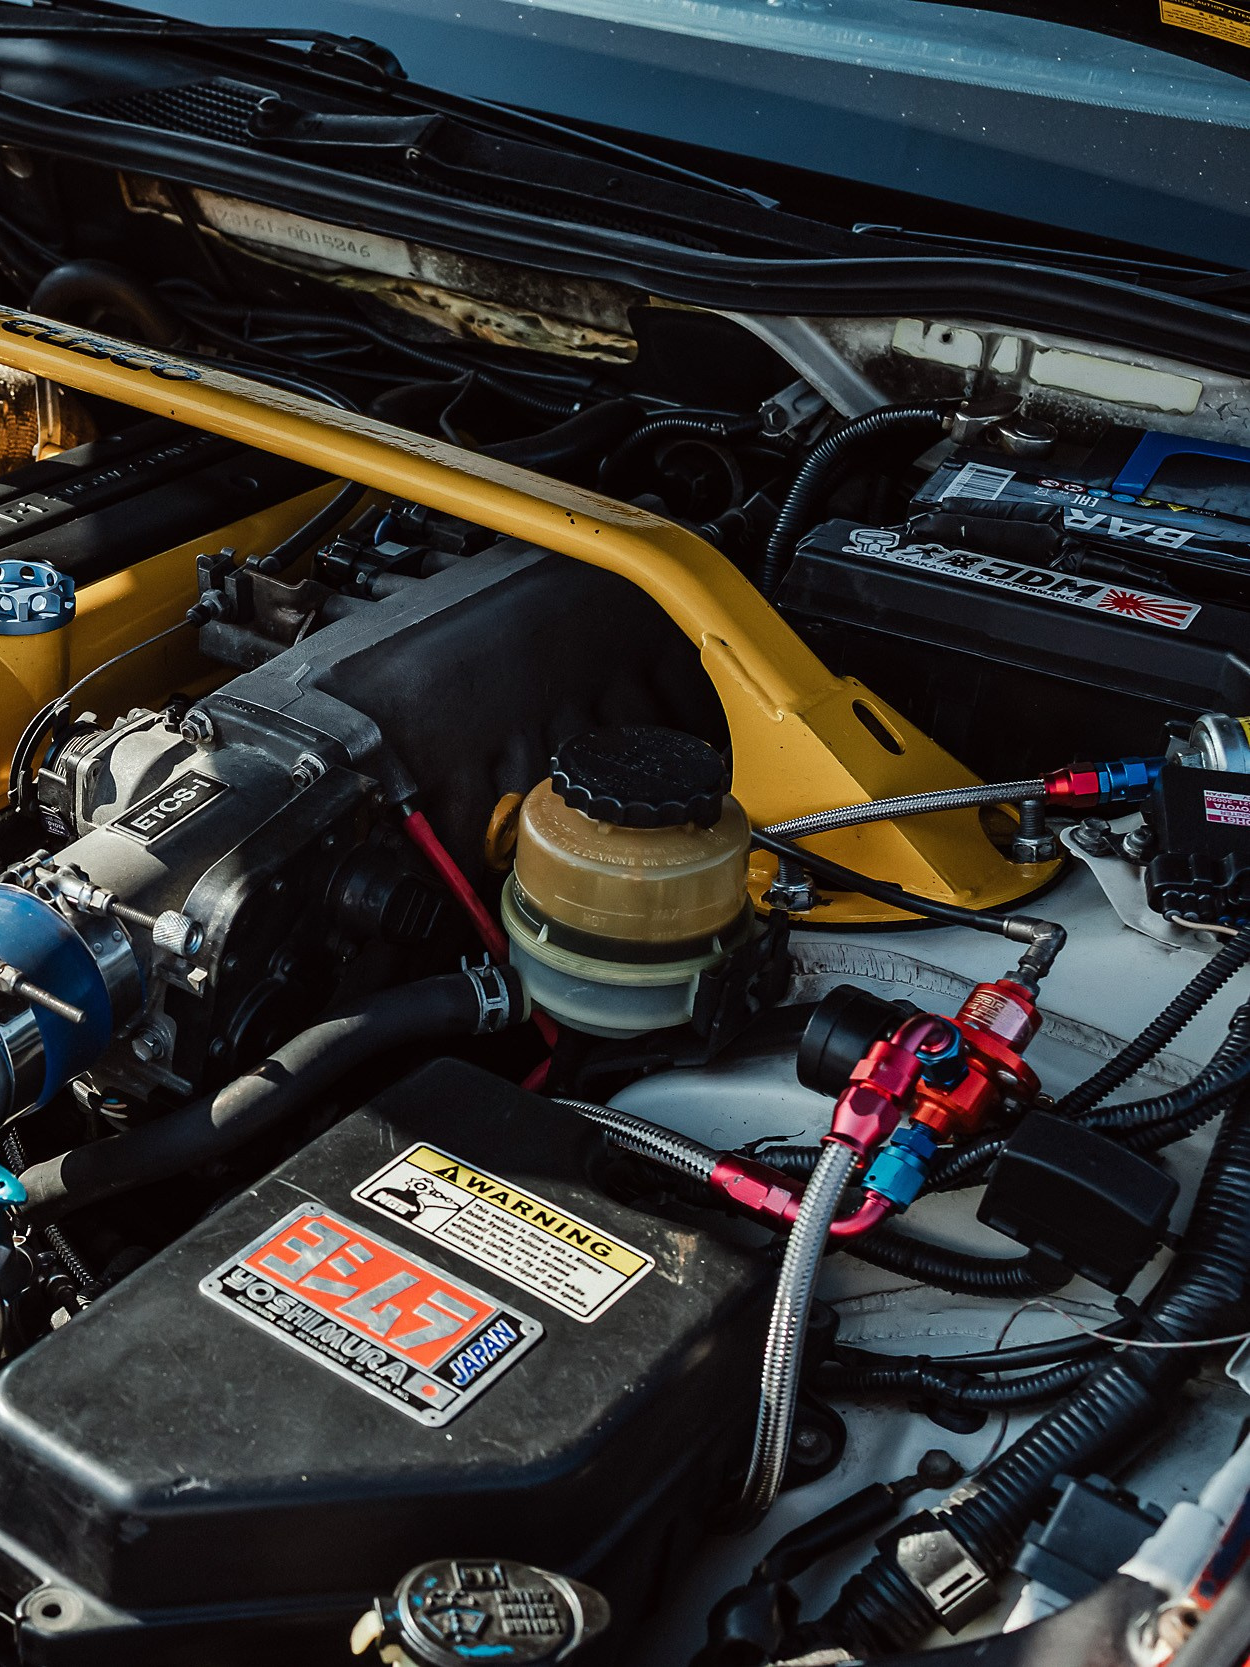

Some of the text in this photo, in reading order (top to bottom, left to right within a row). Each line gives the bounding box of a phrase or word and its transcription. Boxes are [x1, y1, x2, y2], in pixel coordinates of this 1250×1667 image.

[978, 561, 1104, 599] JDM
[130, 778, 211, 831] ETCS-i
[466, 1175, 613, 1258] WARNING
[259, 1221, 478, 1350] ヨシムラ
[223, 1267, 409, 1386] YOSHIMURA
[452, 1319, 518, 1387] JAPAN
